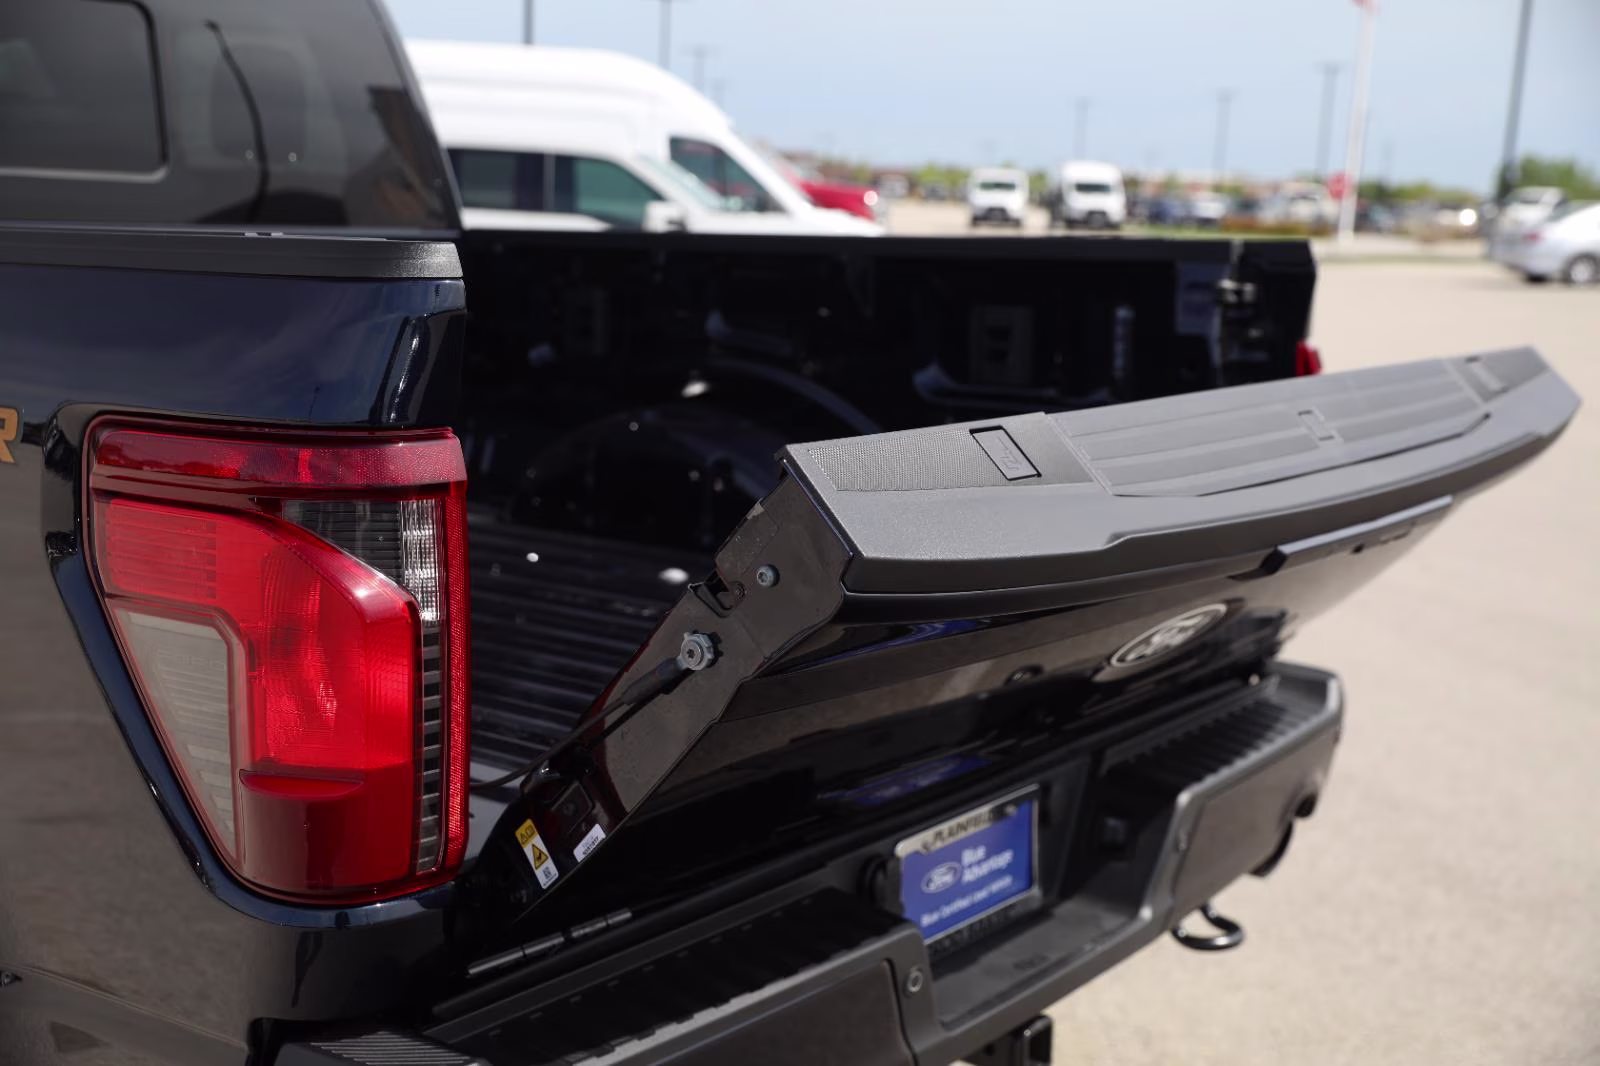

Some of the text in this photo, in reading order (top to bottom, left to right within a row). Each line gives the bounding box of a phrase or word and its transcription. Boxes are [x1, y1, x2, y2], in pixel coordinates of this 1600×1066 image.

[0, 406, 18, 464] R
[961, 845, 986, 866] Blue
[961, 849, 1014, 884] Advantage
